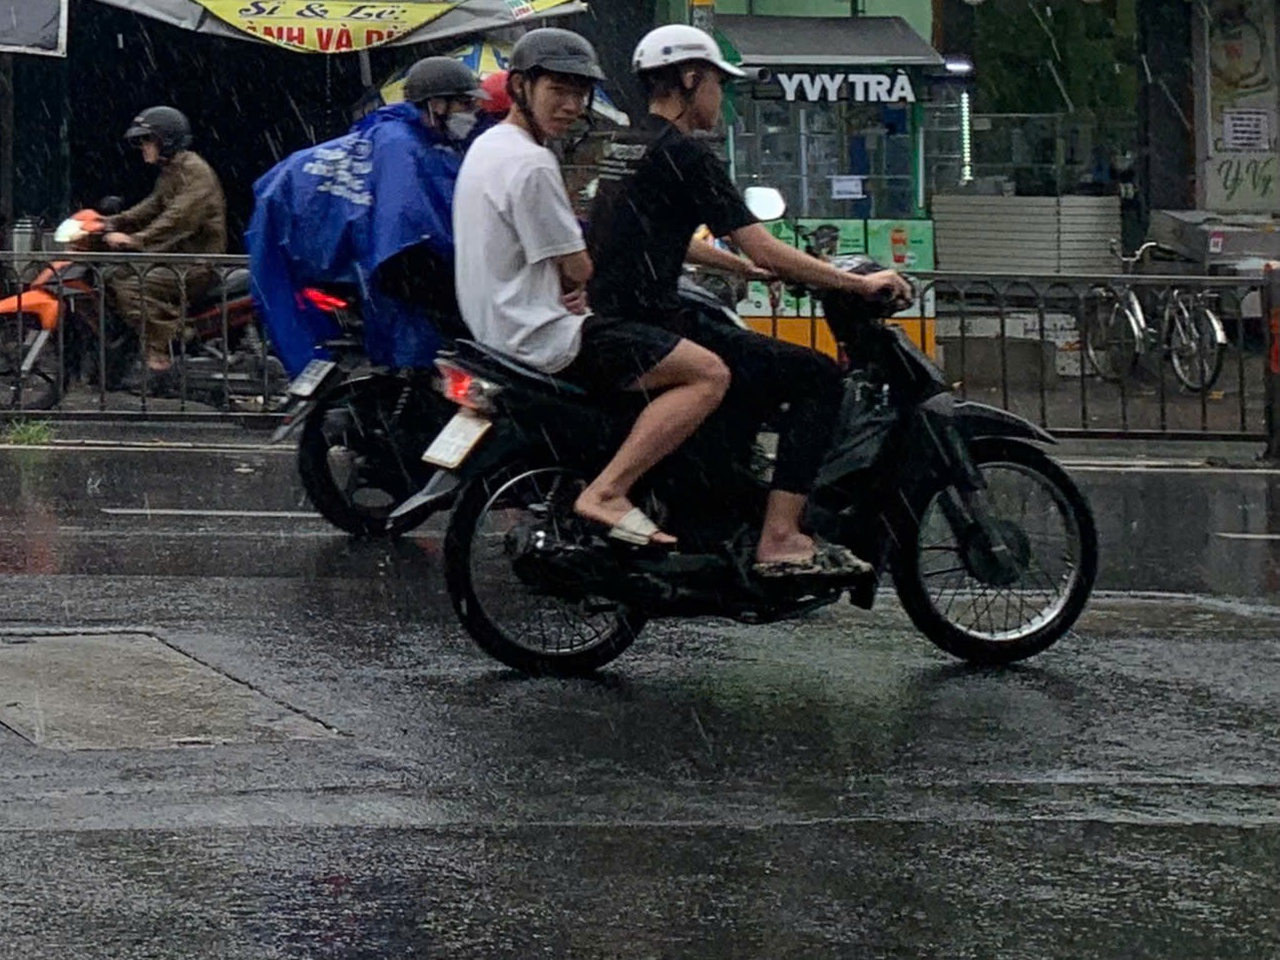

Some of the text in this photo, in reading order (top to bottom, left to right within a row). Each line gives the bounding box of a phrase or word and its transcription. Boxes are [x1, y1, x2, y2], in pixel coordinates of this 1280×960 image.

[296, 3, 329, 19] &
[316, 22, 354, 52] VÀ
[777, 68, 917, 103] YVY TRÀ
